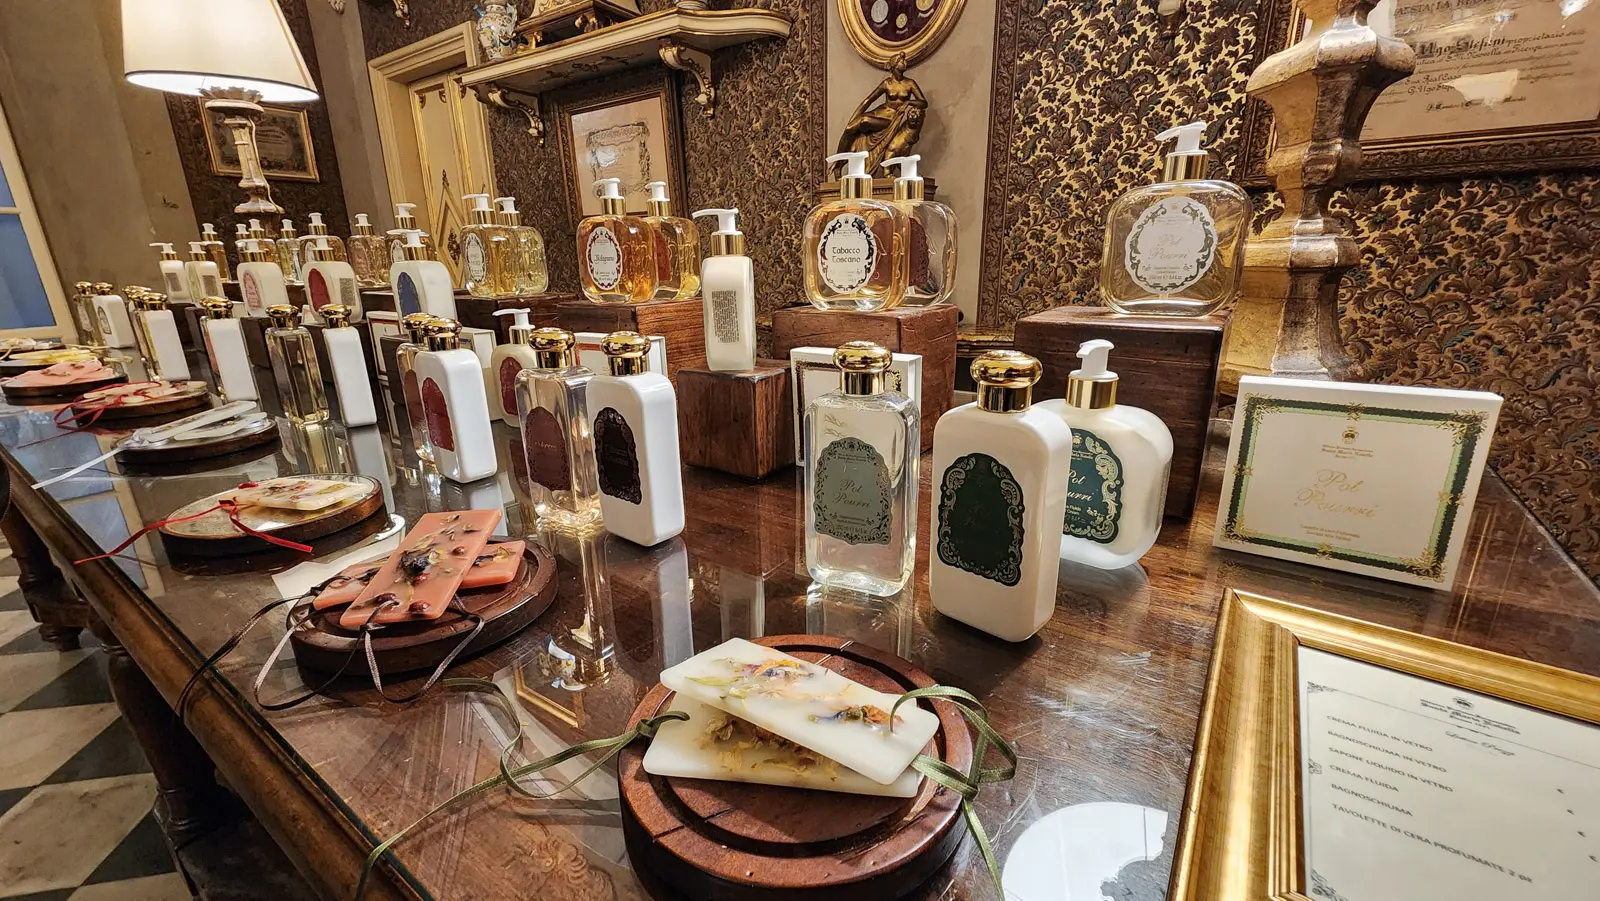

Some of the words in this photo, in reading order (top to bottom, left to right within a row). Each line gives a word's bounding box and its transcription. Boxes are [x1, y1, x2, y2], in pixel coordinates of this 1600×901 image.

[832, 246, 861, 255] Tabacco
[832, 255, 861, 264] Toscano
[839, 478, 864, 494] Pot
[1314, 468, 1364, 493] Pot
[831, 490, 873, 509] Pourri
[1066, 491, 1095, 501] urri
[1293, 487, 1380, 518] Pourri
[1326, 714, 1357, 729] CREMA
[1358, 725, 1389, 739] FLUIDA
[1402, 738, 1433, 752] VETRO
[1327, 730, 1401, 758] BAGNOSCHIUMA
[1402, 754, 1413, 762] IN
[1415, 759, 1448, 773] VETRO
[1328, 746, 1364, 763] SAPONE
[1366, 759, 1406, 776] LIQUIDO
[1407, 773, 1419, 781] IN
[1420, 777, 1454, 793] VETRO
[1329, 764, 1363, 780] CREMA
[1365, 776, 1400, 793] FLUIDA
[1331, 783, 1414, 817] BAGNOSCHIUMA
[1332, 802, 1388, 829] TAVOLETTE
[1390, 824, 1402, 834] DI
[1403, 829, 1432, 846] CERA
[1433, 841, 1505, 873] PROFUMATE
